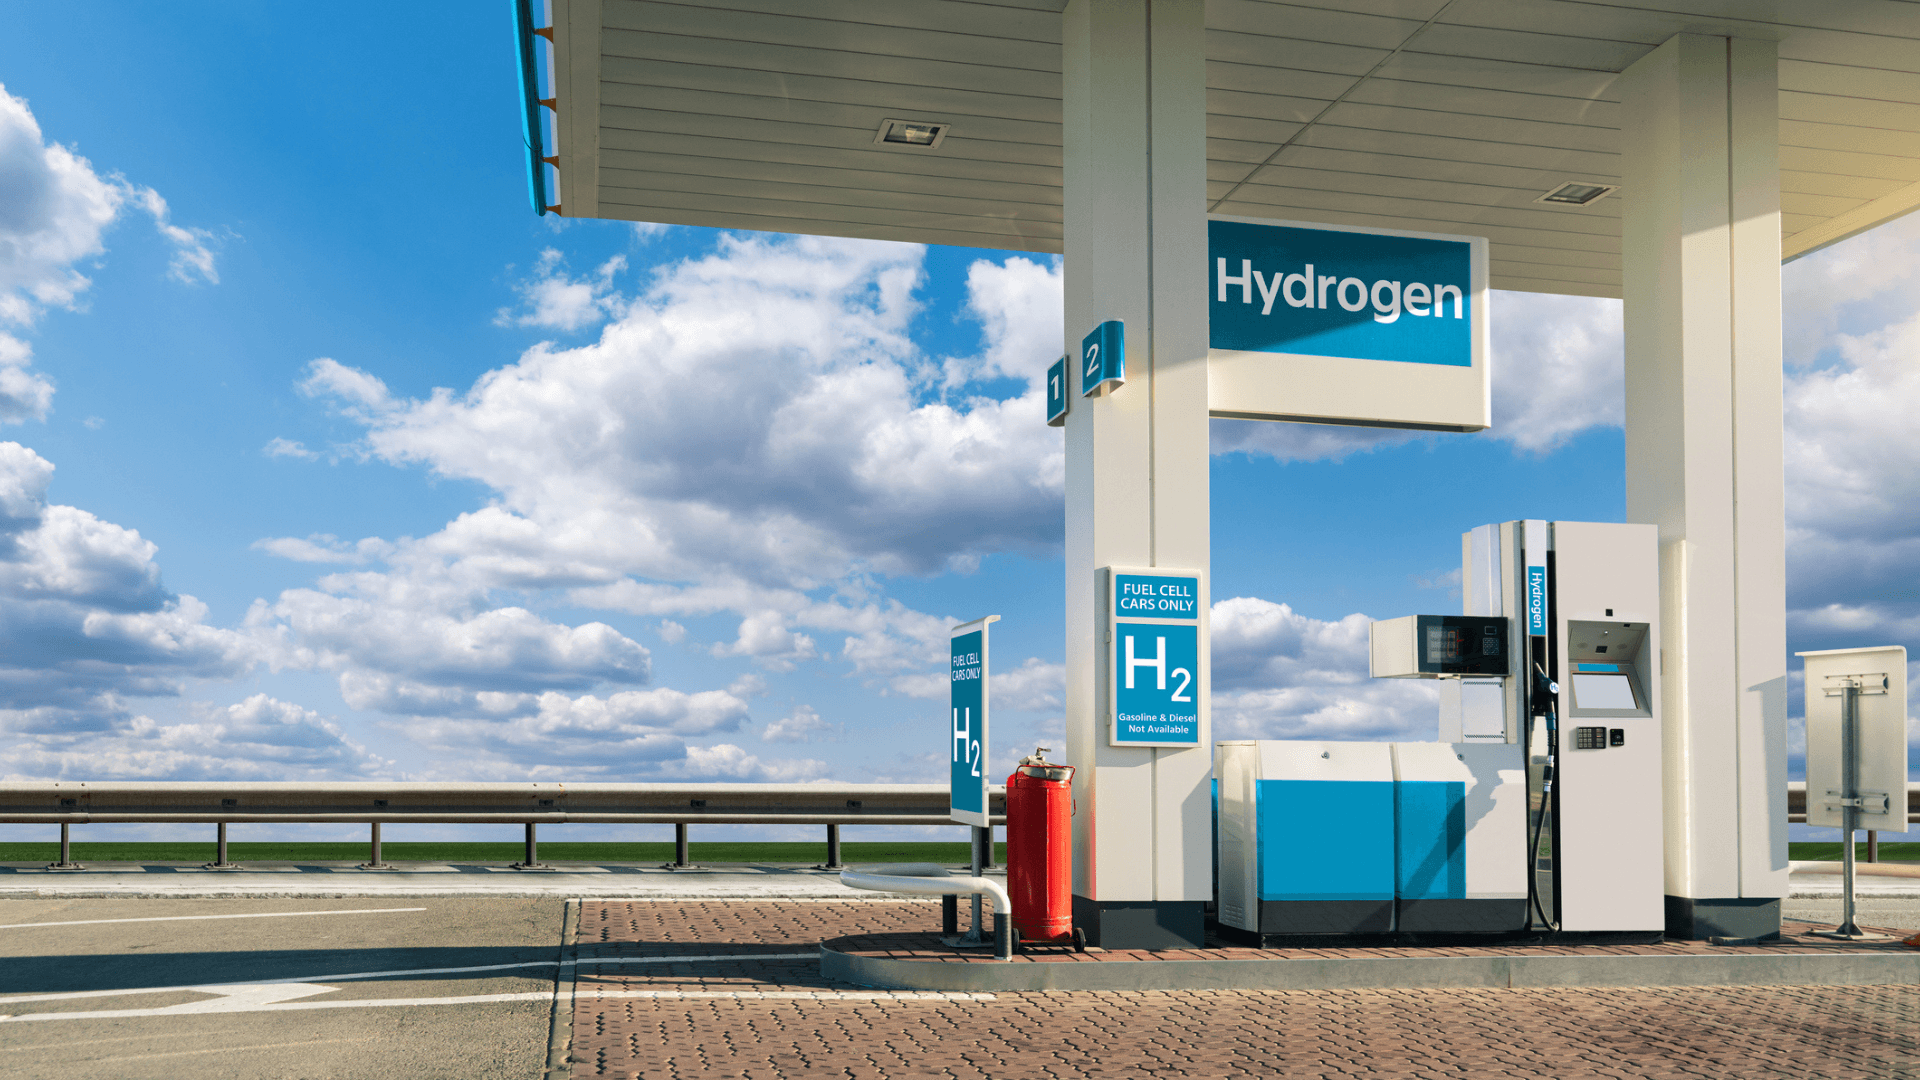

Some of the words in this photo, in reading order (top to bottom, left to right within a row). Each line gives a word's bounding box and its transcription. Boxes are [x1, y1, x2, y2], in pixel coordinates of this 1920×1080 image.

[1217, 257, 1463, 324] Hydrogen
[1086, 343, 1099, 377] 2
[1050, 373, 1059, 401] 1
[1123, 583, 1157, 596] FUEL
[1159, 584, 1191, 597] CELL
[1120, 597, 1156, 610] CARS
[1158, 599, 1194, 612] ONLY
[1531, 573, 1542, 628] Hydrogen
[952, 654, 966, 667] FUEL
[966, 652, 980, 665] CELL
[952, 669, 966, 682] CARS
[966, 667, 981, 680] ONLY
[1118, 712, 1158, 722] Gasoline
[1159, 713, 1167, 722] &
[1169, 713, 1197, 723] Diesel
[1128, 725, 1146, 734] Not
[1147, 725, 1189, 734] Available
